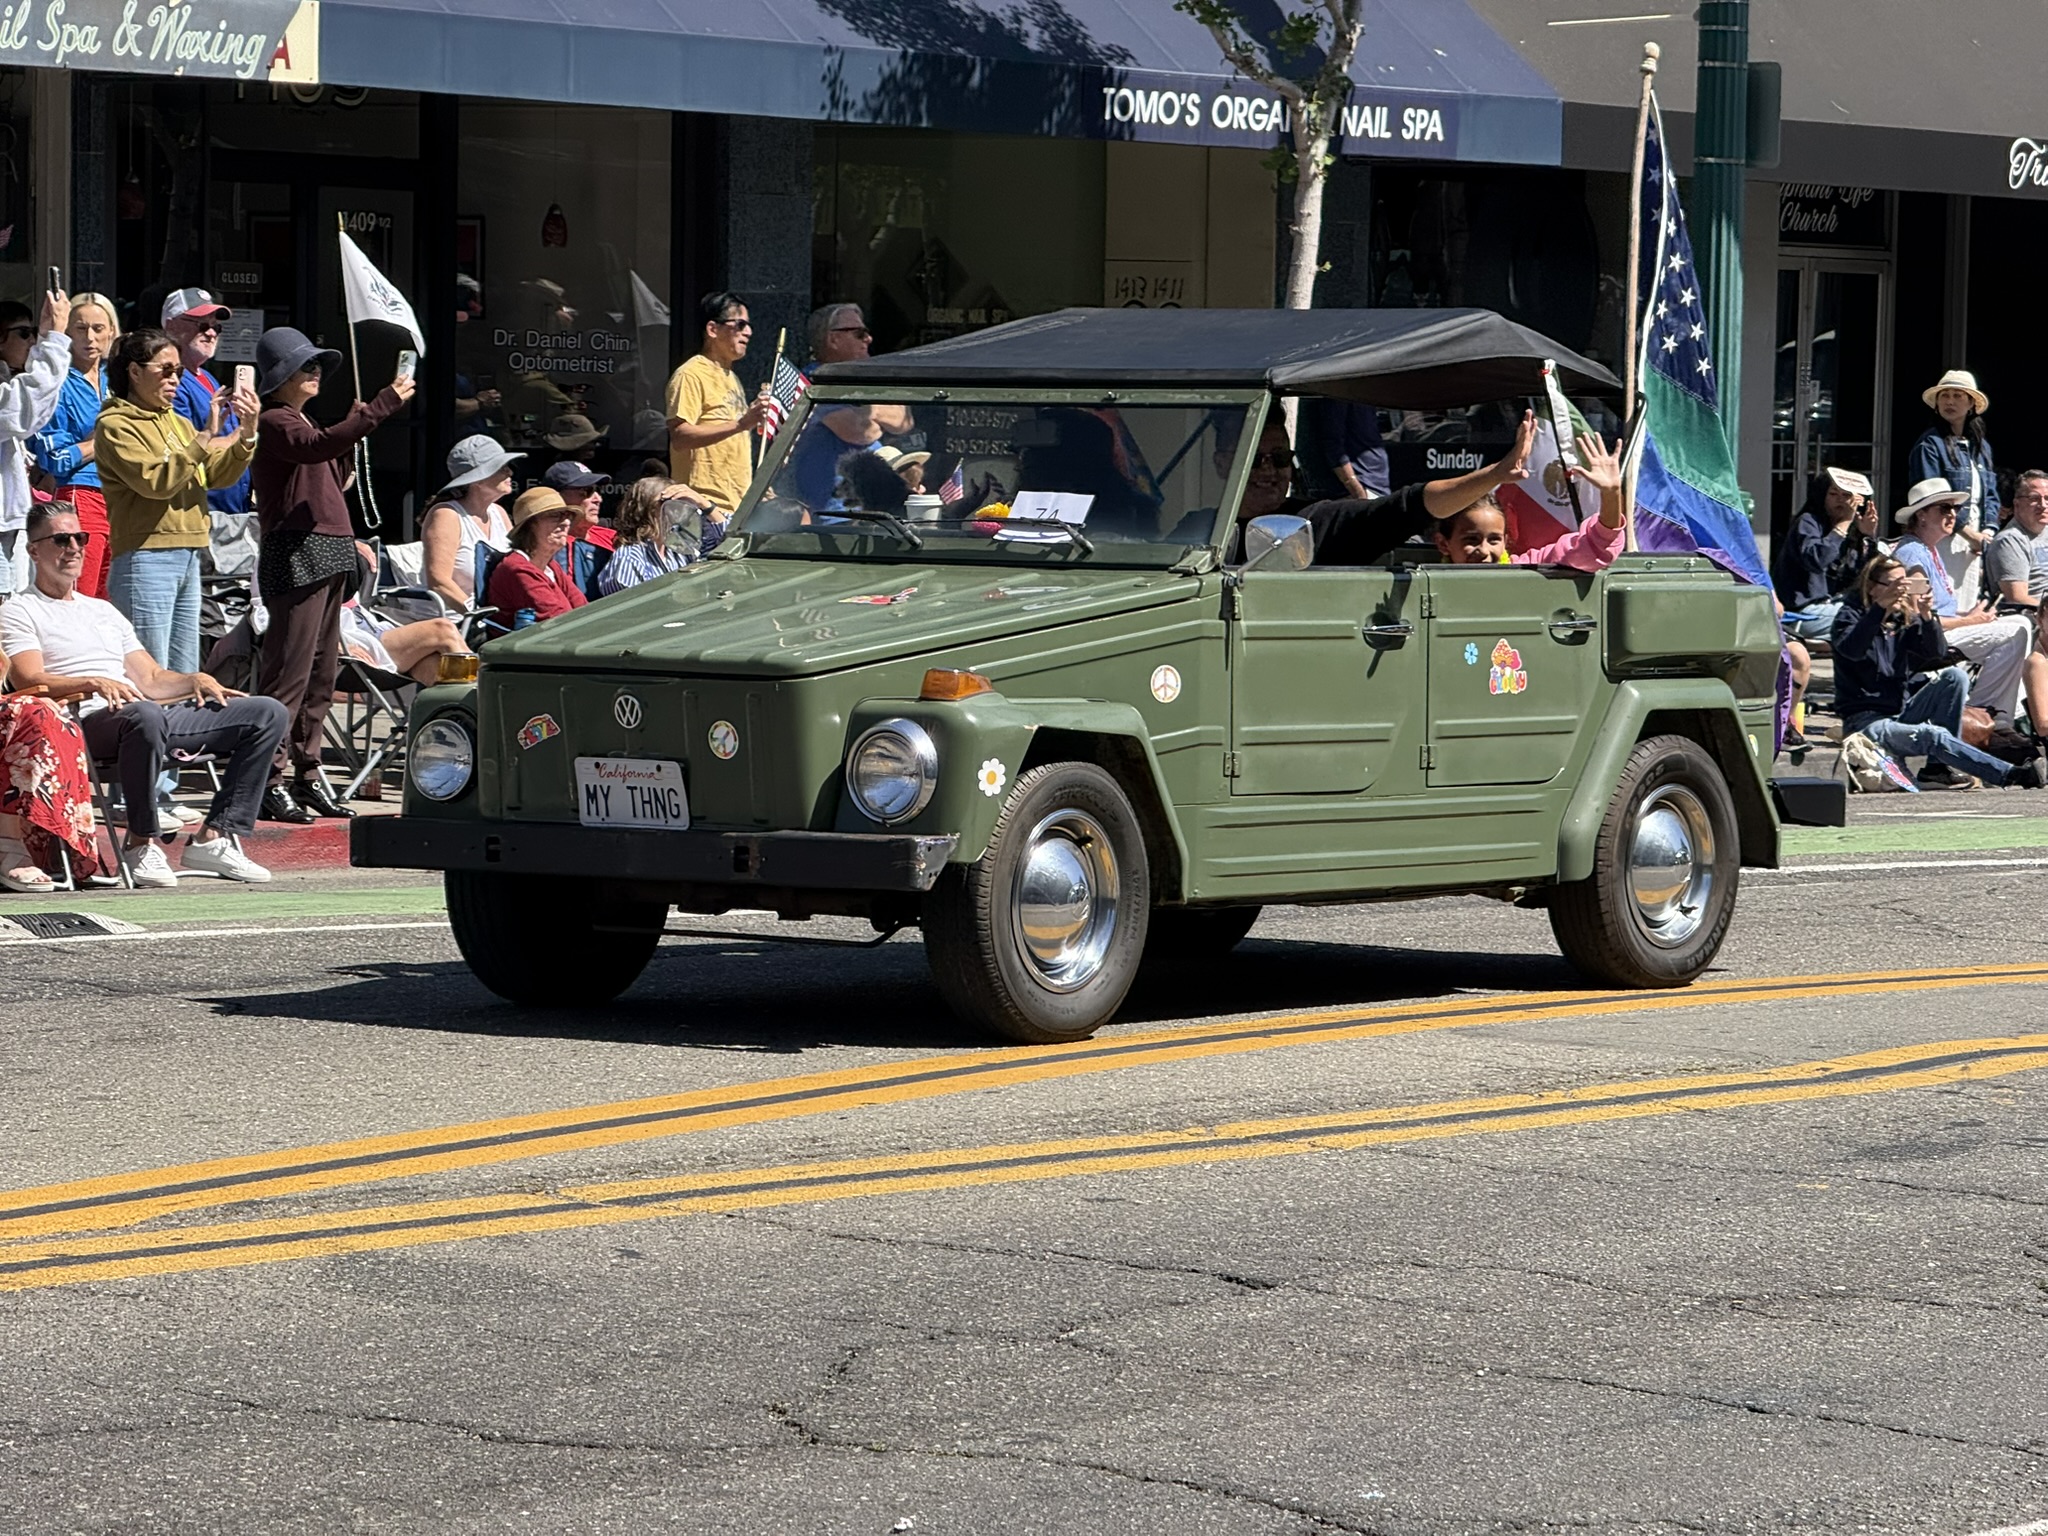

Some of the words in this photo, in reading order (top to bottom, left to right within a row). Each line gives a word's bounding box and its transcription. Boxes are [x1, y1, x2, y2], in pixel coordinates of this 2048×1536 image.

[37, 0, 101, 64] Spa
[113, 0, 143, 57] &
[148, 5, 267, 79] Waxing
[1103, 87, 1201, 127] TOMO'S
[1211, 95, 1292, 133] ORGA
[1340, 105, 1392, 139] NAIL
[1401, 107, 1444, 141] SPA
[1780, 201, 1838, 233] Church
[221, 272, 257, 284] CLOSED
[493, 329, 517, 346] Dr.
[526, 330, 582, 349] Daniel
[590, 333, 631, 351] Chin
[508, 352, 614, 374] Optometrist
[1426, 448, 1484, 470] Sunday
[598, 762, 663, 783] California
[585, 783, 611, 819] MY
[626, 785, 681, 820] THNG
[1687, 885, 1734, 970] IRONMAN
